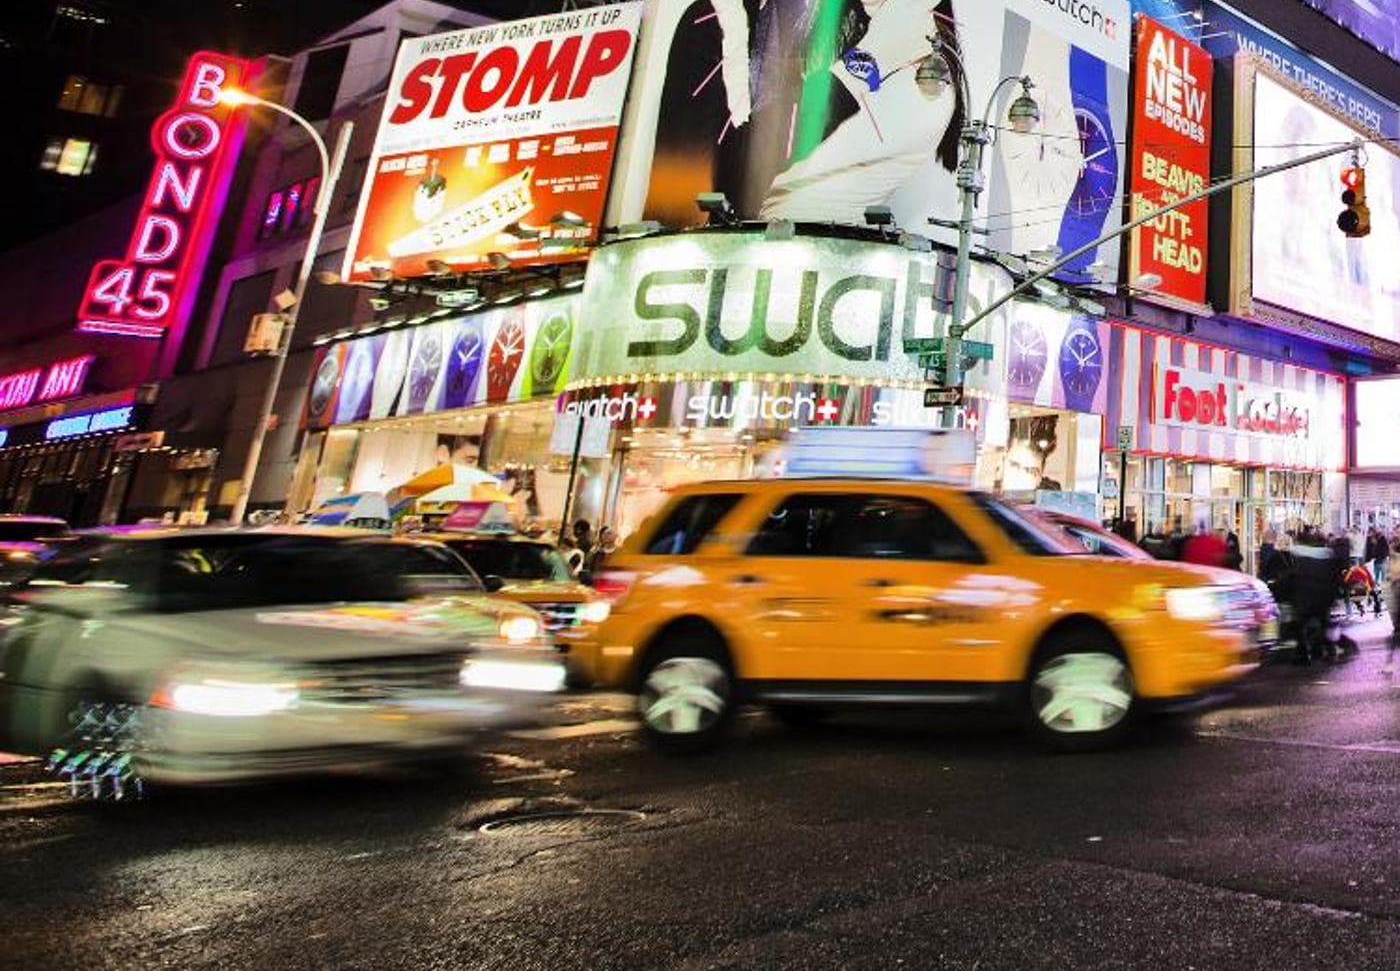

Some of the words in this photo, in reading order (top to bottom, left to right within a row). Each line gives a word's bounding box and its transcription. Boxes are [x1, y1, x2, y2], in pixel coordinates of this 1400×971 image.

[421, 33, 462, 54] WHERE
[466, 27, 497, 47] NEW
[501, 21, 536, 42] YORK
[539, 14, 581, 38] TURNS
[585, 13, 598, 28] IT
[602, 9, 621, 25] UP
[389, 29, 632, 125] STOMP
[1148, 31, 1198, 84] ALL
[1146, 62, 1206, 120] NEW
[1145, 98, 1206, 144] EPISODES
[1349, 99, 1382, 134] PEPSI
[135, 63, 225, 263] BOND
[1153, 236, 1202, 275] HEAD
[94, 268, 176, 318] 45
[687, 392, 816, 421] swatch
[1164, 370, 1227, 427] Foot
